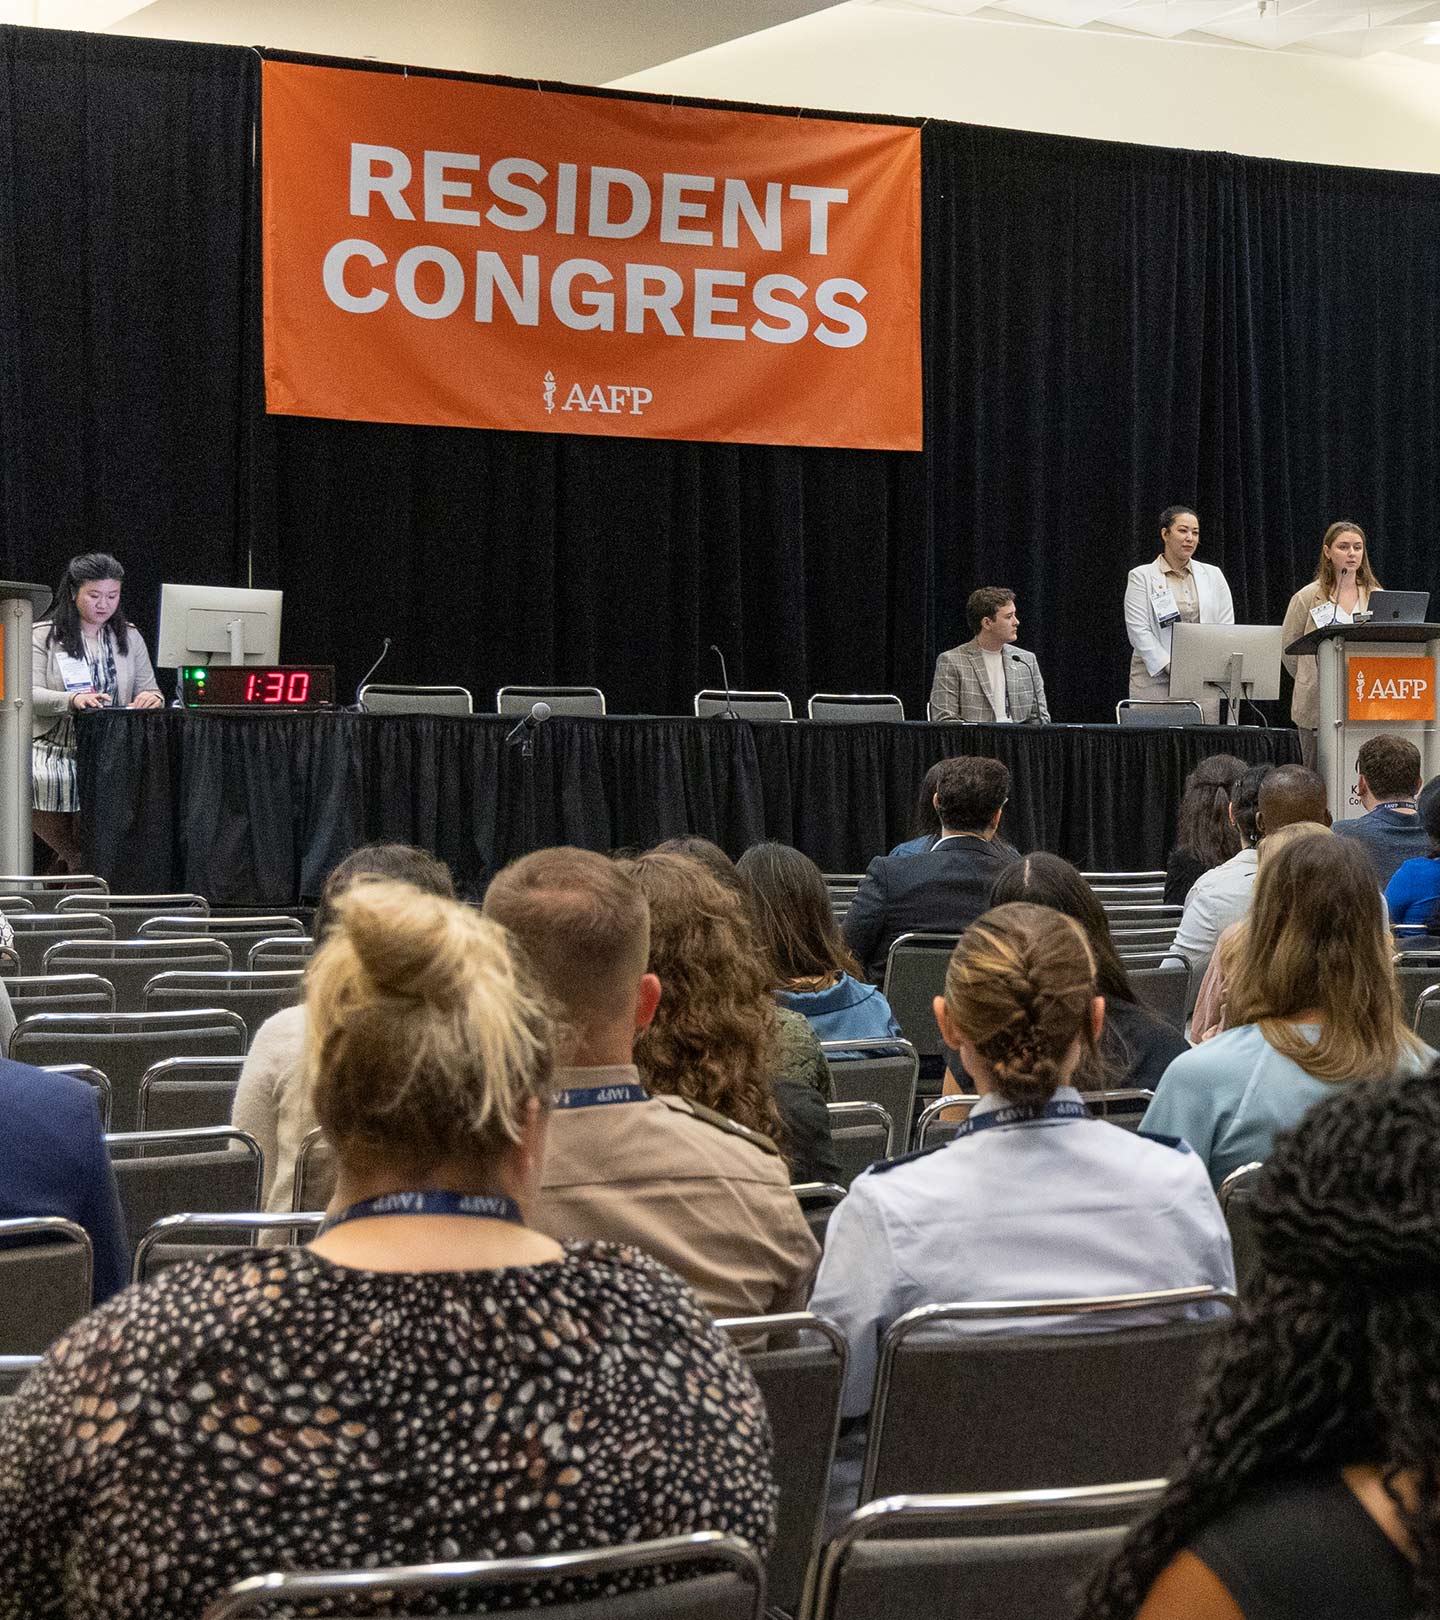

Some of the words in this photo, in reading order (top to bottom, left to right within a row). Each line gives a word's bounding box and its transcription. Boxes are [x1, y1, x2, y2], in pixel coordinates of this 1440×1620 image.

[349, 142, 848, 255] RESIDENT
[322, 238, 868, 348] CONGRESS
[561, 383, 653, 415] AAFP
[247, 672, 309, 702] 1:30
[1368, 679, 1427, 699] AAFP
